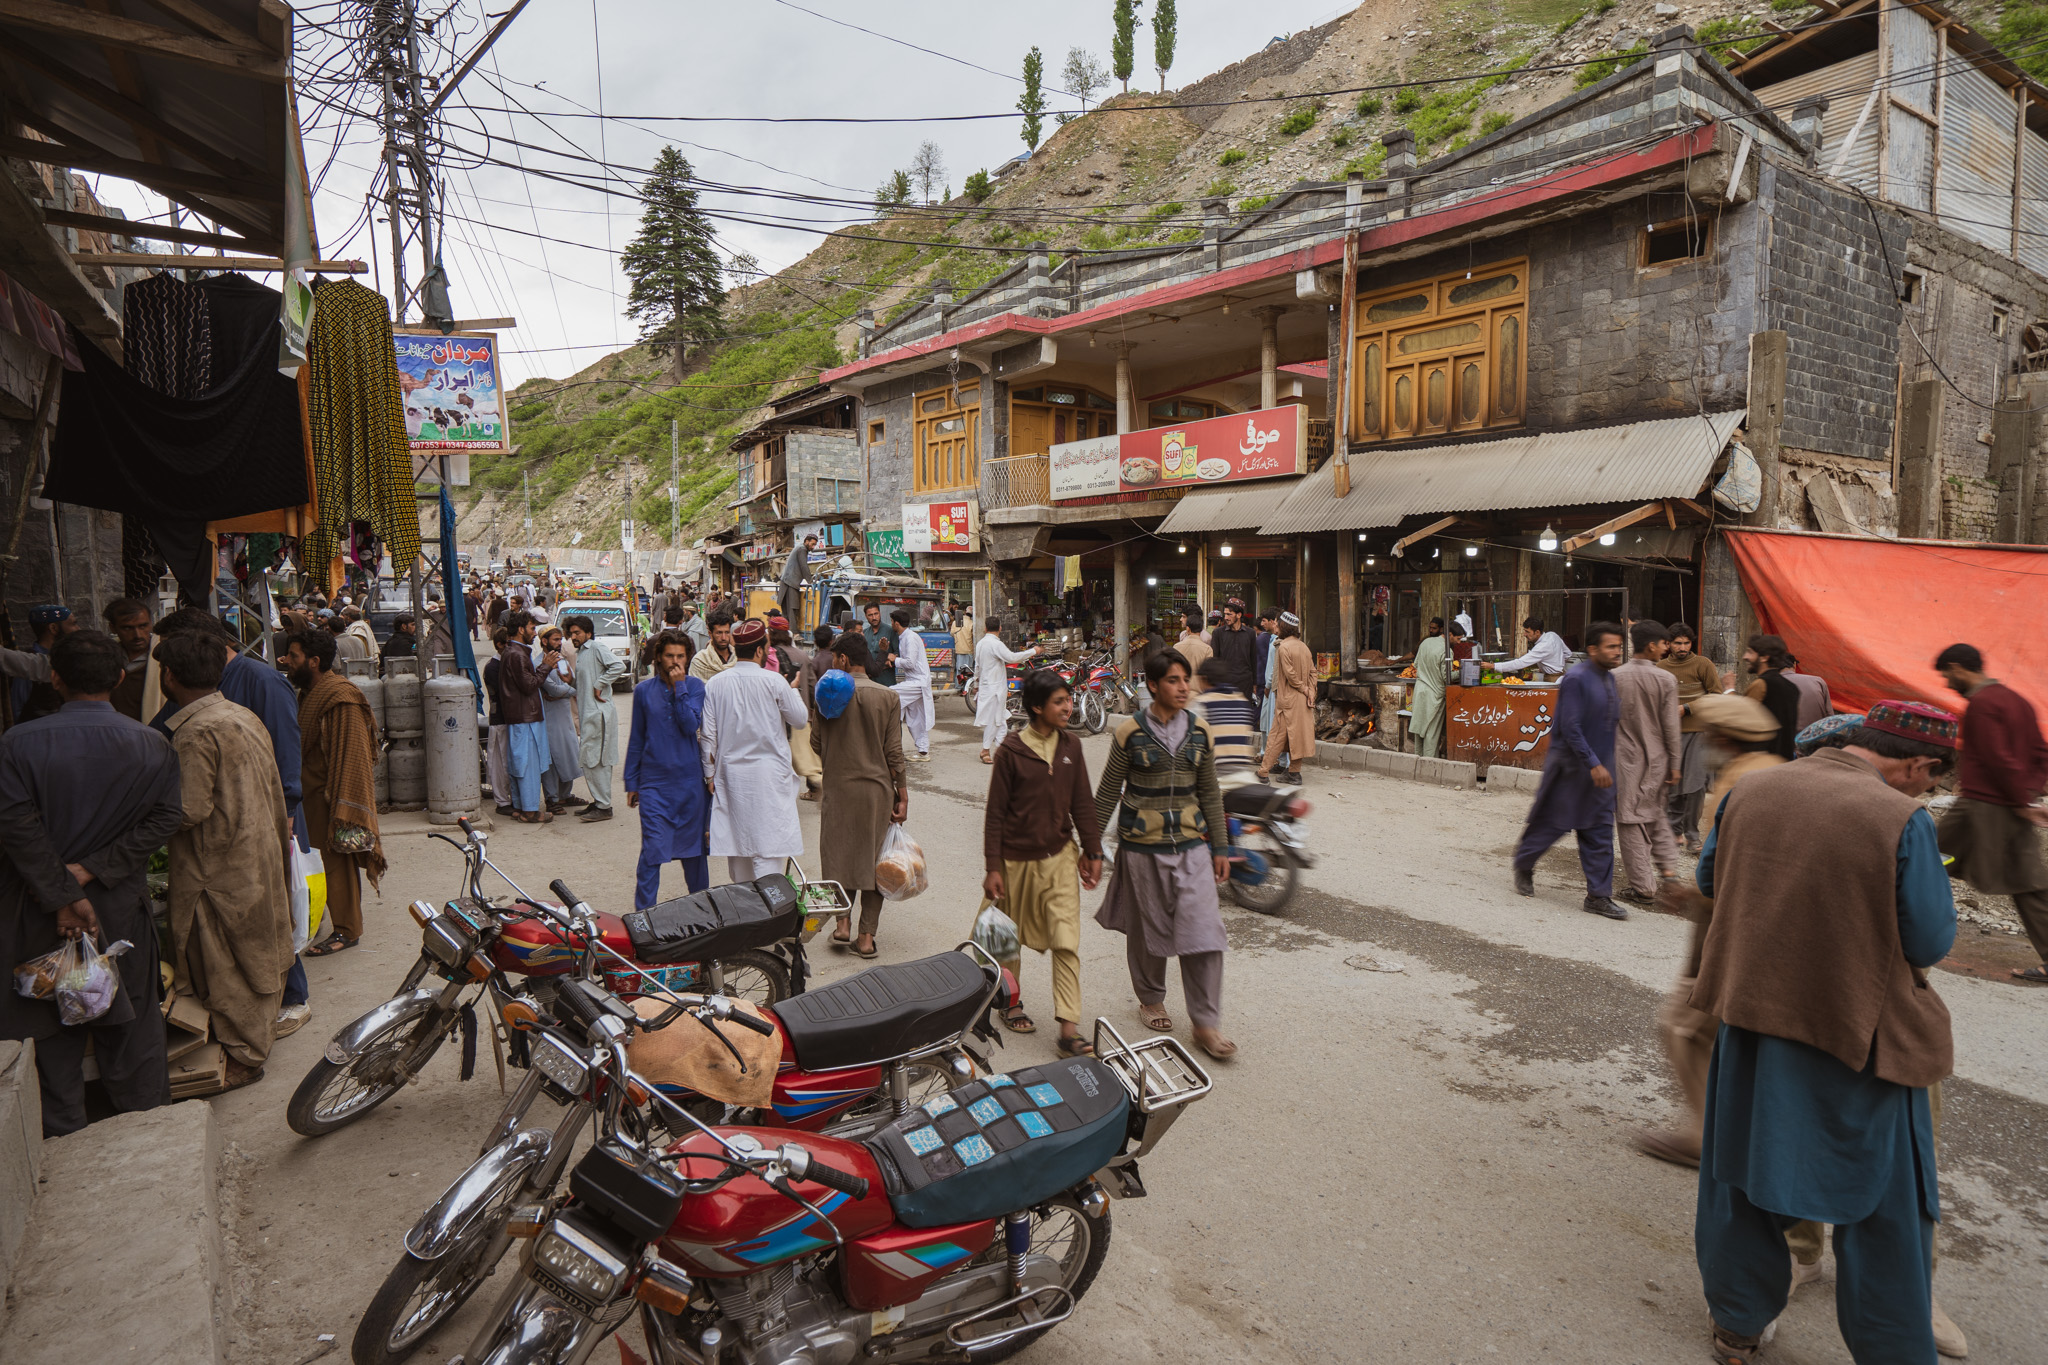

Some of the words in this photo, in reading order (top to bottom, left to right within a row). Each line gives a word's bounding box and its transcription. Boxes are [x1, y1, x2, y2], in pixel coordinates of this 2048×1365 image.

[432, 340, 490, 365] مردان
[434, 368, 475, 393] ابرار
[1240, 419, 1280, 455] صوفی
[1165, 450, 1181, 460] SUFI
[951, 506, 967, 518] SUFI
[1472, 704, 1497, 727] پوڑی
[1067, 1064, 1099, 1098] SPORTS
[535, 1272, 587, 1312] HONDA
